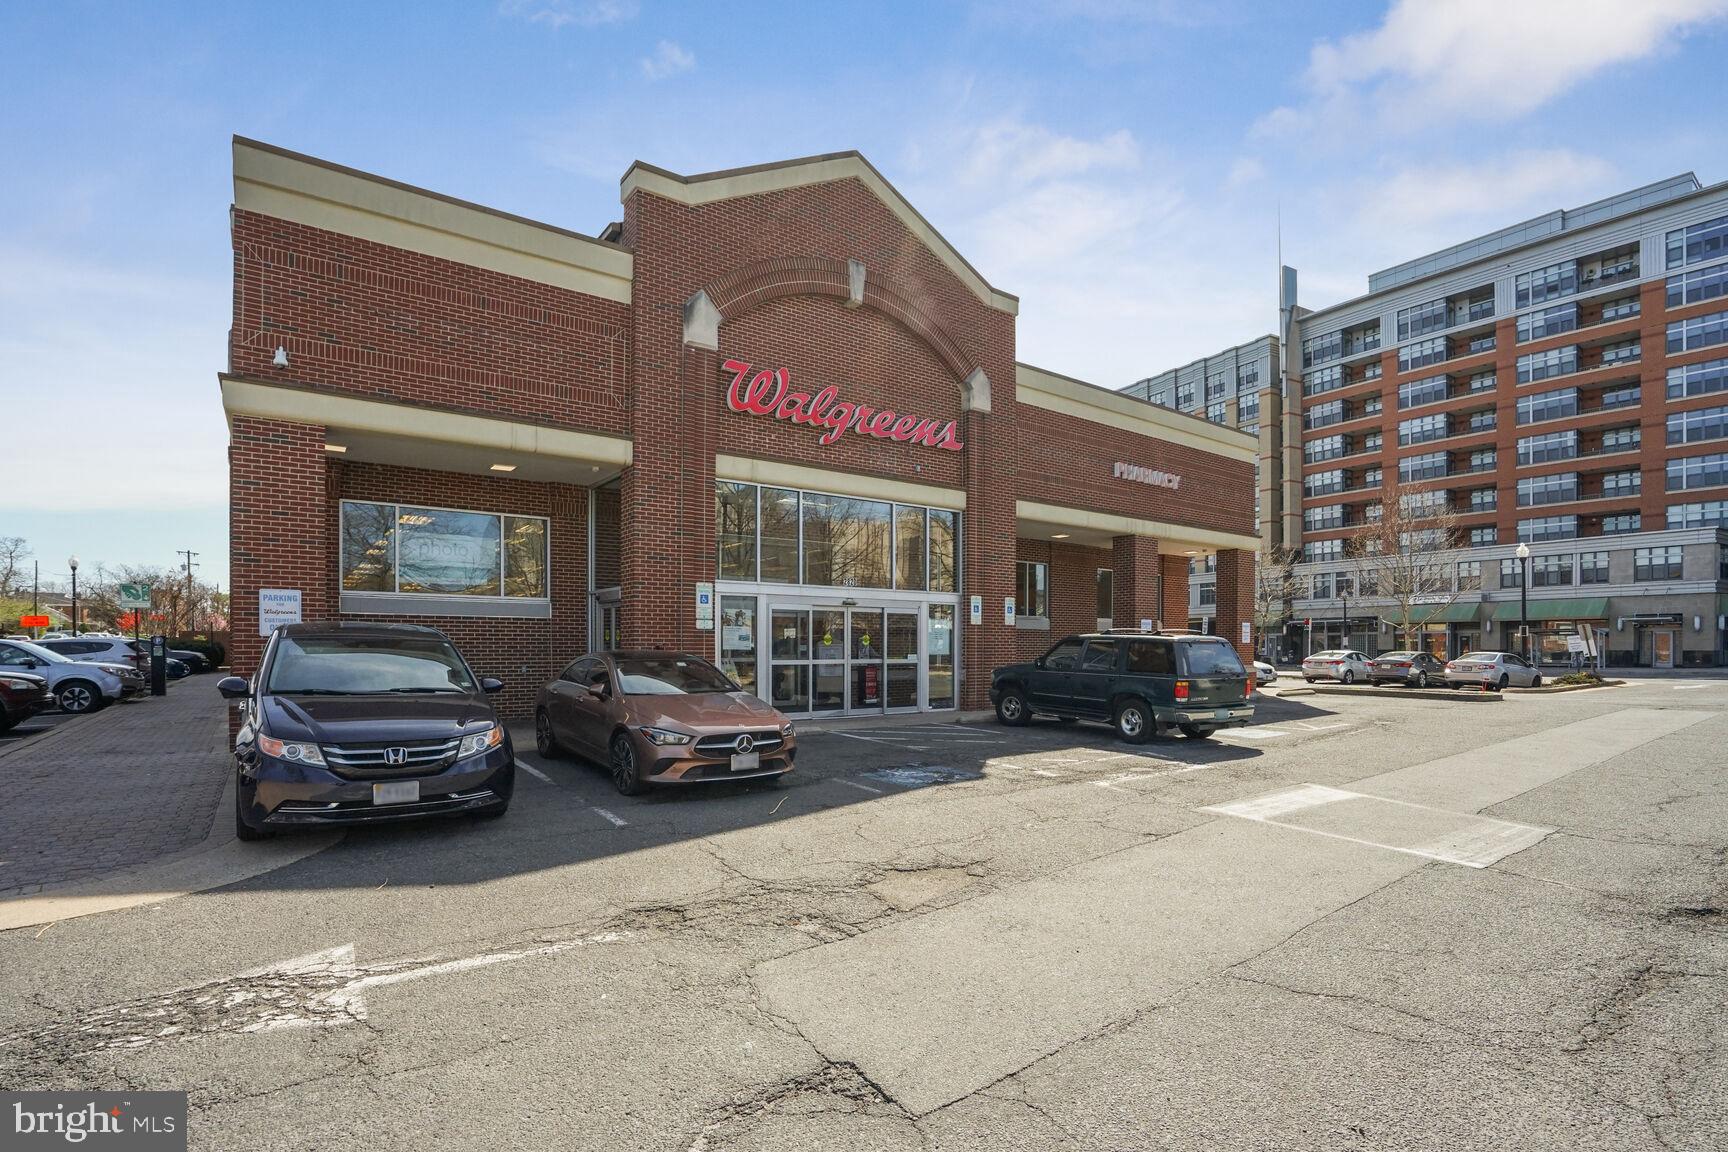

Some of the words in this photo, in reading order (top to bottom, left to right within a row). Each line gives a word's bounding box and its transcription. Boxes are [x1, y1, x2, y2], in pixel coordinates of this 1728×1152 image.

[722, 359, 964, 450] Walgreens
[1114, 461, 1181, 490] PHARMACY
[262, 594, 298, 602] PARKING
[263, 608, 298, 616] Walgreens
